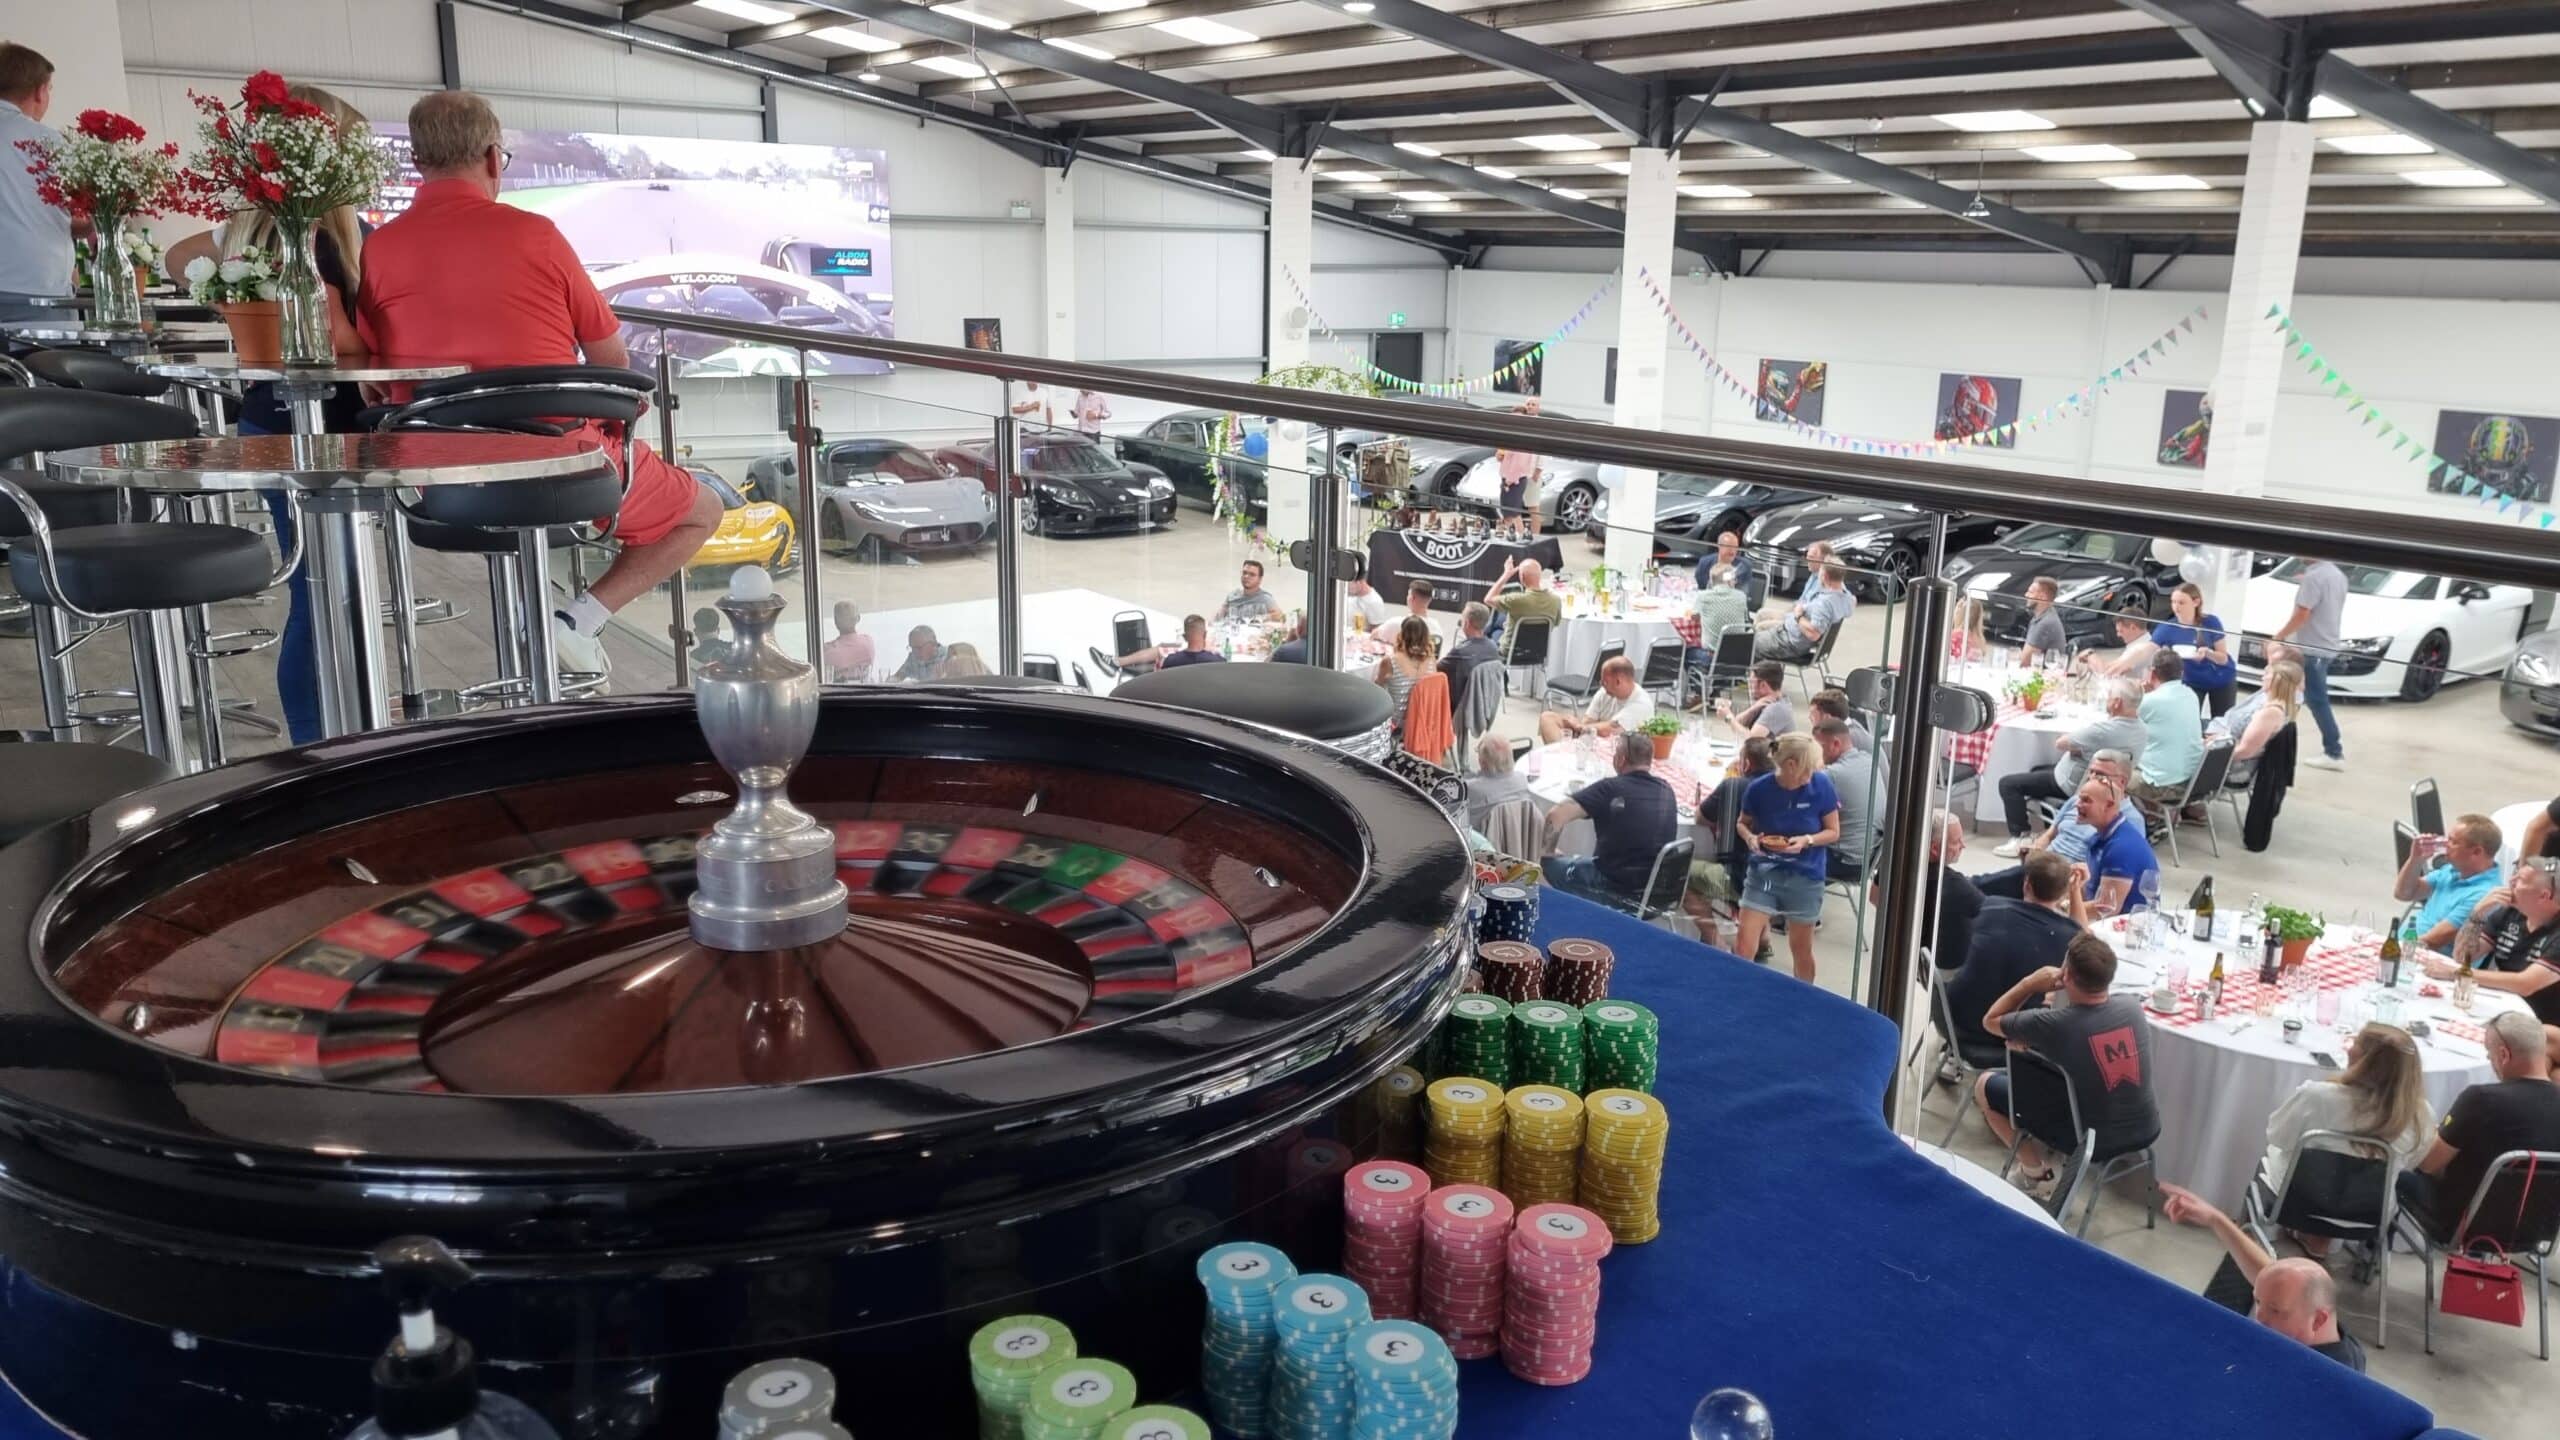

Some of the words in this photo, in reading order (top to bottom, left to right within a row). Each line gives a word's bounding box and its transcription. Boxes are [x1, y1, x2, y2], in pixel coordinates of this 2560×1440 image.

[835, 251, 869, 259] ALBON
[836, 258, 869, 266] RADIO
[670, 274, 737, 284] VELO.COM
[1425, 541, 1464, 559] BOOT
[2104, 1040, 2129, 1063] M
[1451, 1089, 1475, 1100] 3
[1529, 1096, 1556, 1107] 3
[1616, 1099, 1634, 1111] 3
[1373, 1173, 1400, 1186] 3
[1456, 1200, 1481, 1213] 3
[1547, 1217, 1574, 1232] 3
[1231, 1259, 1260, 1272] 3
[1309, 1292, 1334, 1309] 3
[1006, 1335, 1038, 1351] 3
[1384, 1340, 1408, 1358] 3
[764, 1380, 798, 1397] 3
[1068, 1379, 1100, 1398] 3
